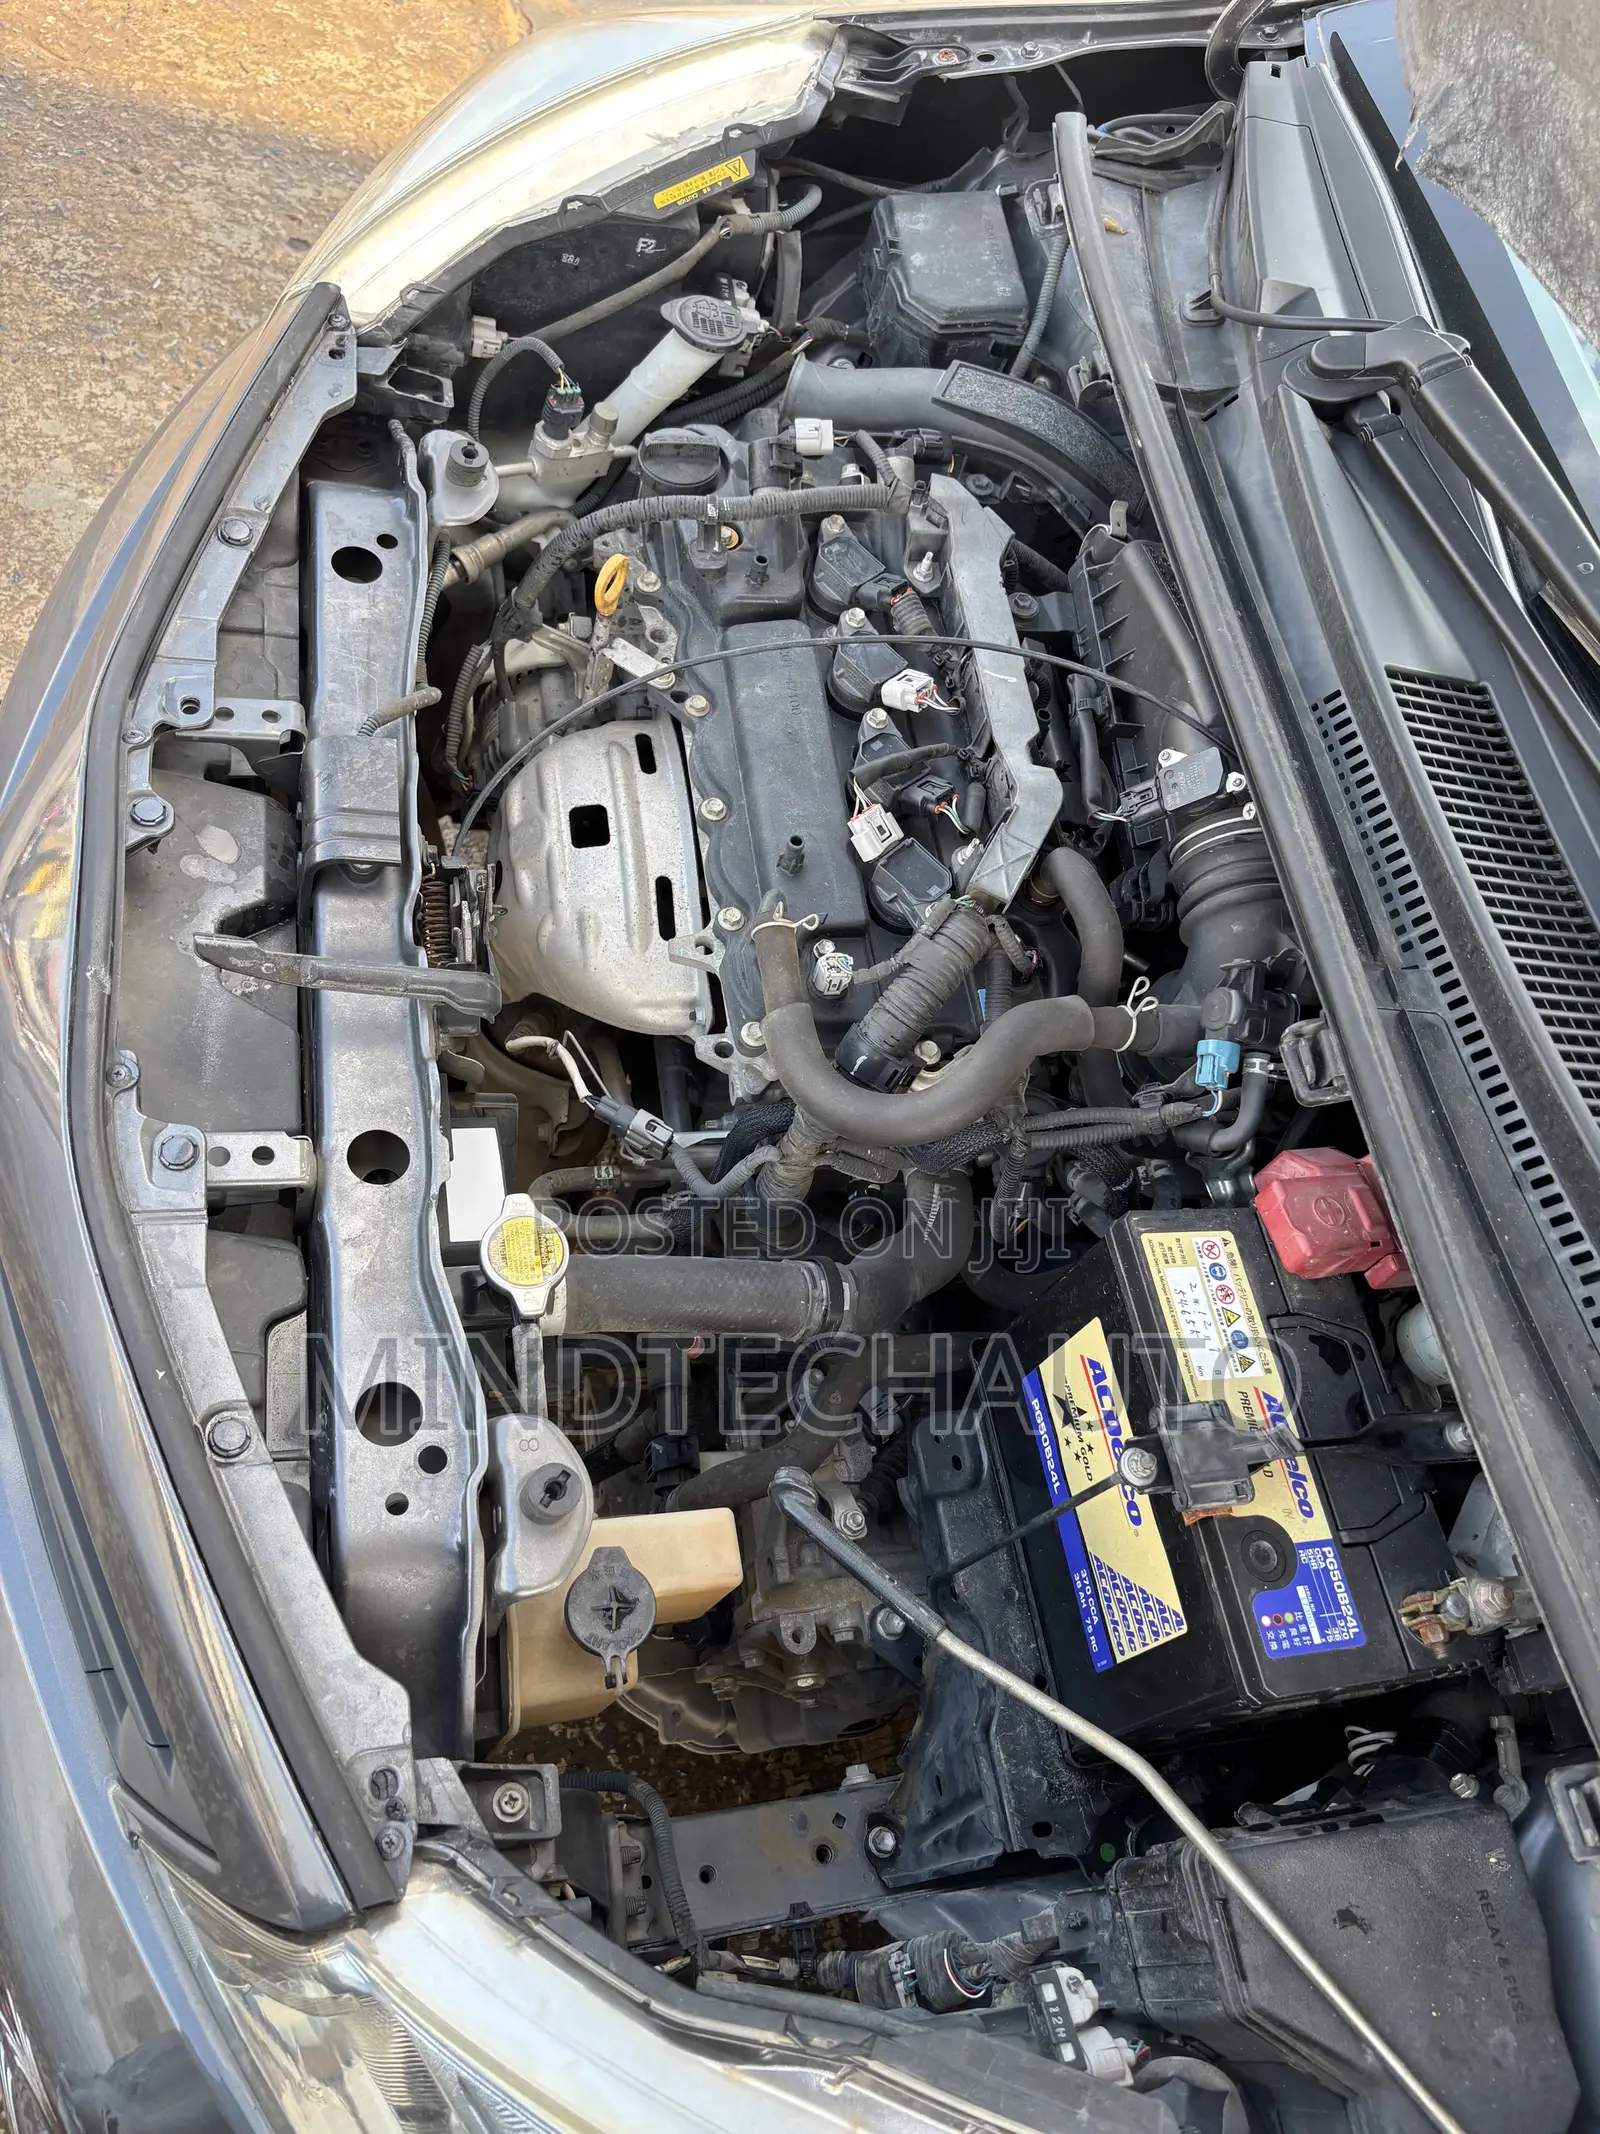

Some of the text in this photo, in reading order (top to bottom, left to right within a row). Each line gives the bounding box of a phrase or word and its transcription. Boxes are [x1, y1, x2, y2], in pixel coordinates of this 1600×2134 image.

[1031, 1397, 1062, 1495] PG50B24L
[1064, 1383, 1094, 1482] PREMIUM GOLD
[1073, 1572, 1098, 1653] 36 AH 75 RC
[1080, 1568, 1099, 1625] 370 CCA
[1093, 1554, 1126, 1657] ACDelco
[1298, 1549, 1334, 1643] RC 75
[1306, 1548, 1342, 1641] 5HR 36
[1314, 1547, 1350, 1640] CCA 370
[1321, 1546, 1360, 1640] PG50B24L
[1475, 1888, 1506, 1950] RELAY
[1503, 1974, 1530, 2026] FUSE
[1049, 2005, 1067, 2038] 12H
